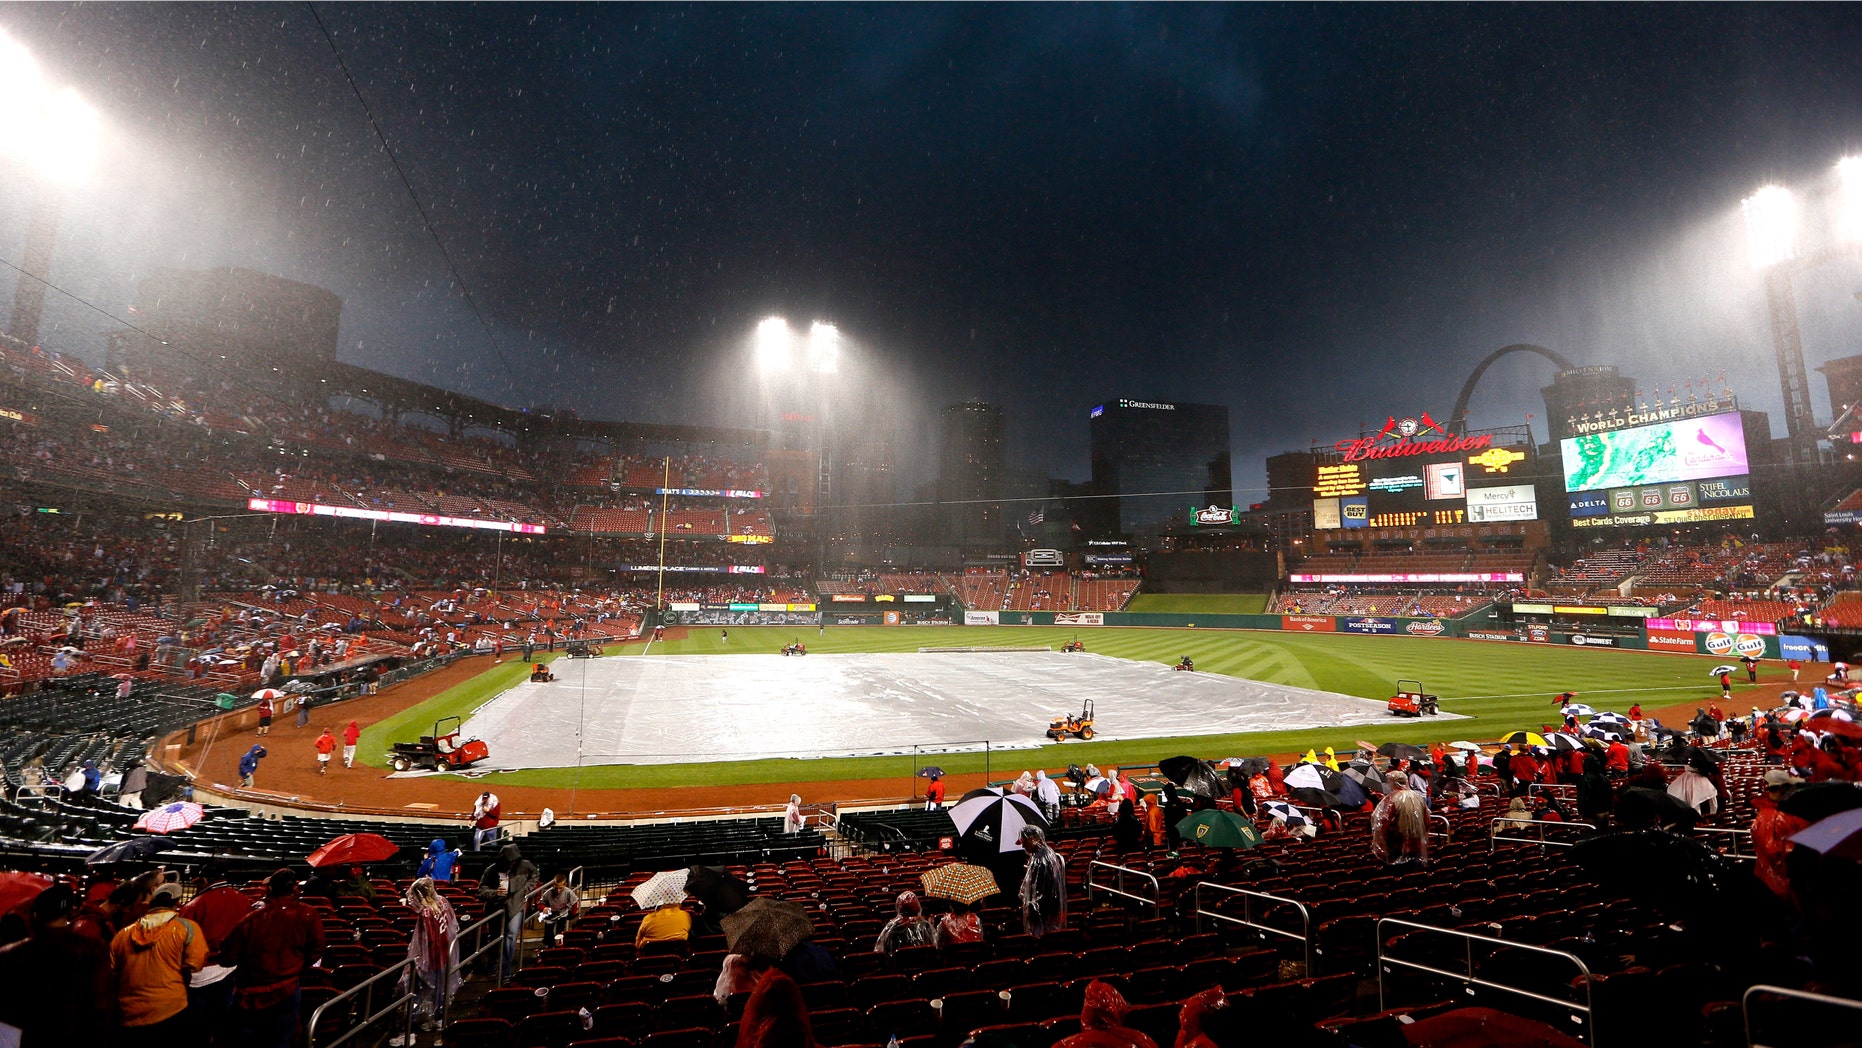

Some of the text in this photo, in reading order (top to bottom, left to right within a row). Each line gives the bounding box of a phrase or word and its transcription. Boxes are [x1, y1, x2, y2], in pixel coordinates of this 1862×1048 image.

[1128, 400, 1175, 410] GREENSFELDER
[1577, 401, 1719, 433] WORLD CHAMPIONS
[1334, 432, 1494, 462] Budweiser
[1700, 482, 1750, 498] STIFEL NICOLAUS
[1484, 492, 1509, 500] Mercy
[1645, 496, 1658, 504] 66
[1674, 494, 1687, 502] 66
[1578, 500, 1606, 508] DELTA
[1619, 498, 1631, 506] 66
[1486, 505, 1533, 514] HELITECH
[1573, 516, 1651, 527] Best Cards Coverage
[1586, 637, 1613, 645] MIDWEST
[1708, 638, 1732, 649] Gulf
[1737, 640, 1762, 650] Gulf
